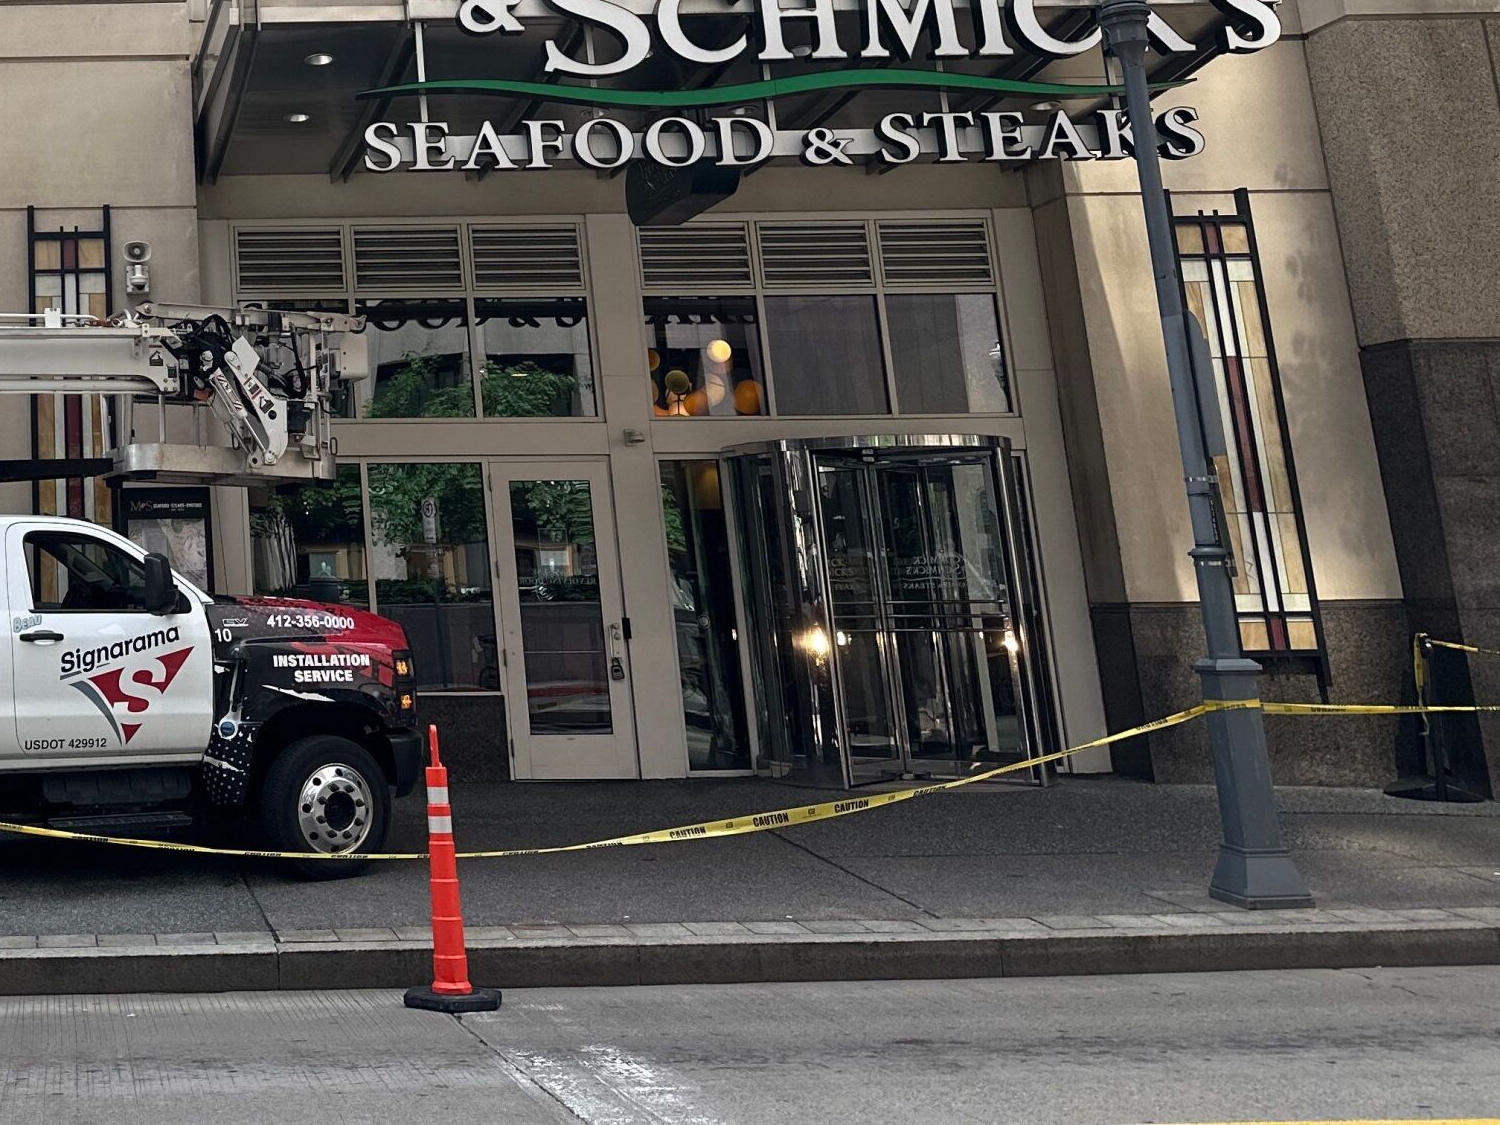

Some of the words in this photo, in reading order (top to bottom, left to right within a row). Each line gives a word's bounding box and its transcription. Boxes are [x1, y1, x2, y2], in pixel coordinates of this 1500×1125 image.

[363, 117, 775, 173] SEAFOOD
[803, 127, 854, 166] &
[876, 106, 1206, 164] STEAKS
[266, 615, 355, 630] 412-356-0000
[214, 628, 232, 643] 10
[60, 625, 180, 674] Signarama
[273, 654, 371, 668] INSTALLATION
[294, 669, 354, 683] SERVICE
[24, 739, 66, 751] USDOT
[68, 737, 107, 749] 429912
[669, 825, 707, 840] CAUTION
[752, 812, 790, 828] CAUTION
[834, 799, 870, 814] CAUTION
